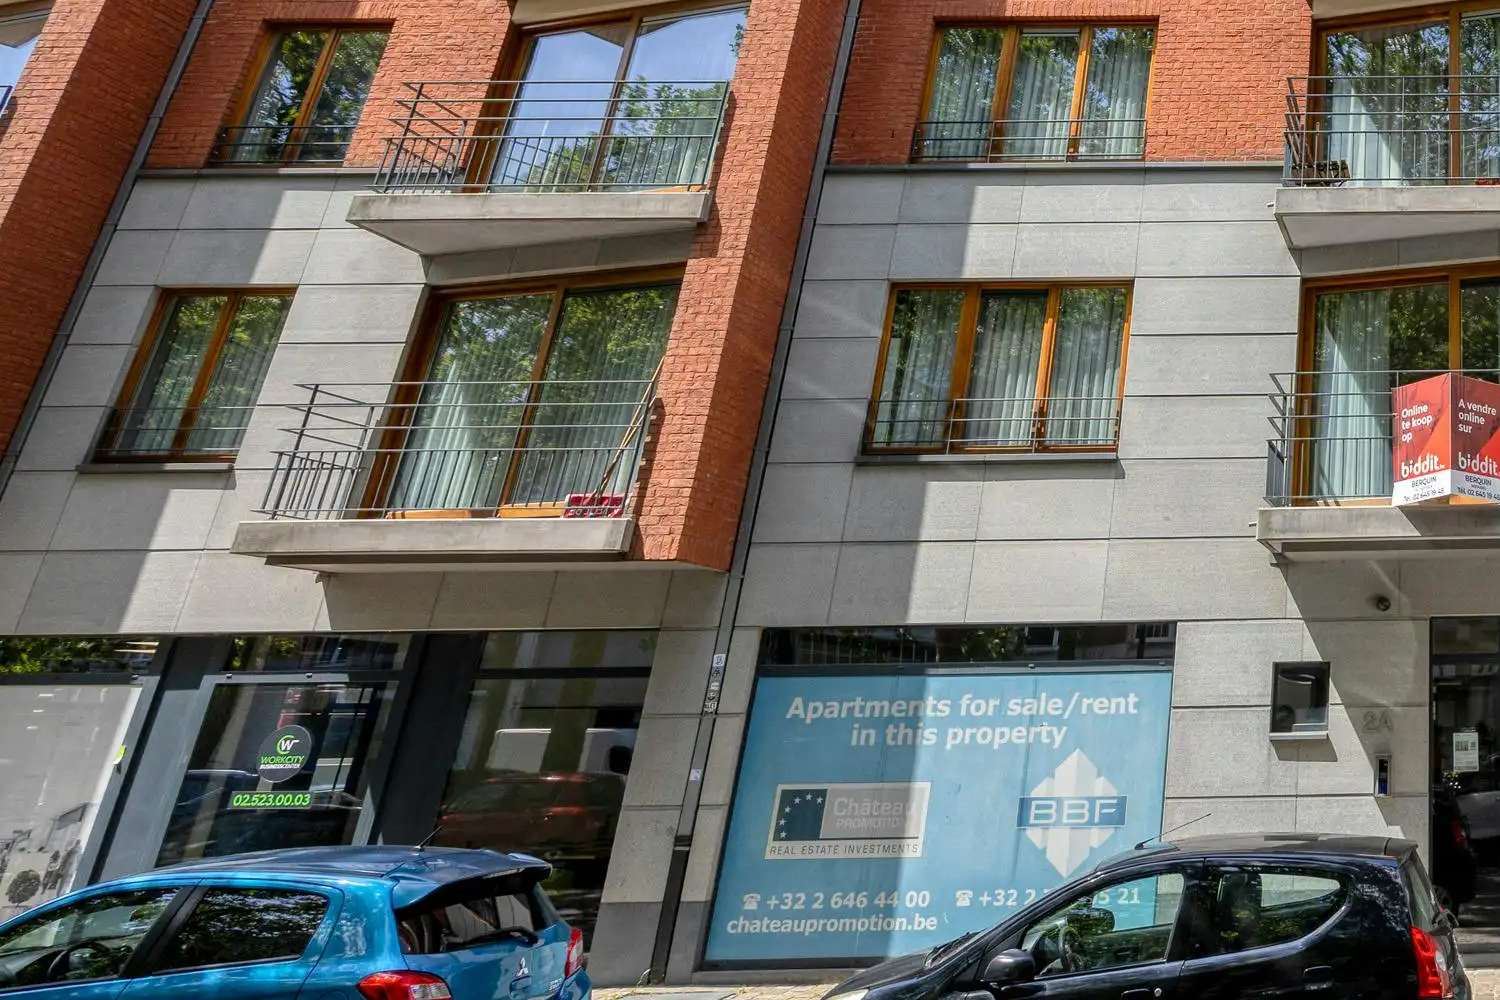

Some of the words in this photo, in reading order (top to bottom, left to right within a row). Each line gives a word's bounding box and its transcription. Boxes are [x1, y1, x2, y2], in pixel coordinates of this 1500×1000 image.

[1401, 403, 1429, 419] Online
[1458, 398, 1465, 408] A
[1466, 400, 1497, 416] vendre
[1401, 419, 1410, 430] te
[1412, 414, 1433, 429] koop
[1458, 411, 1485, 425] online
[1458, 423, 1473, 434] sur
[1401, 431, 1413, 443] op
[1411, 475, 1437, 488] BERQUIN
[1464, 474, 1492, 487] BERQUIN
[1467, 488, 1476, 496] 02
[785, 695, 952, 724] Apartments
[960, 693, 1001, 716] for
[1006, 692, 1139, 720] sale/rent
[1362, 710, 1394, 733] 2A
[850, 722, 876, 746] in
[885, 722, 938, 746] this
[945, 721, 1068, 751] property
[260, 755, 305, 764] WORKCITY
[1029, 799, 1118, 825] BBF
[836, 816, 908, 830] PROMOTIO
[769, 845, 796, 856] REAL
[801, 844, 839, 856] ESTATE
[844, 843, 919, 855] INVESTMENTS
[766, 892, 806, 910] +32
[811, 891, 825, 909] 2
[830, 890, 869, 909] 646
[873, 890, 899, 908] 44
[904, 890, 931, 908] 00
[978, 888, 1018, 907] +32
[1024, 888, 1037, 905] 2
[1117, 887, 1141, 905] 21
[726, 911, 939, 936] chateaupromotion.be
